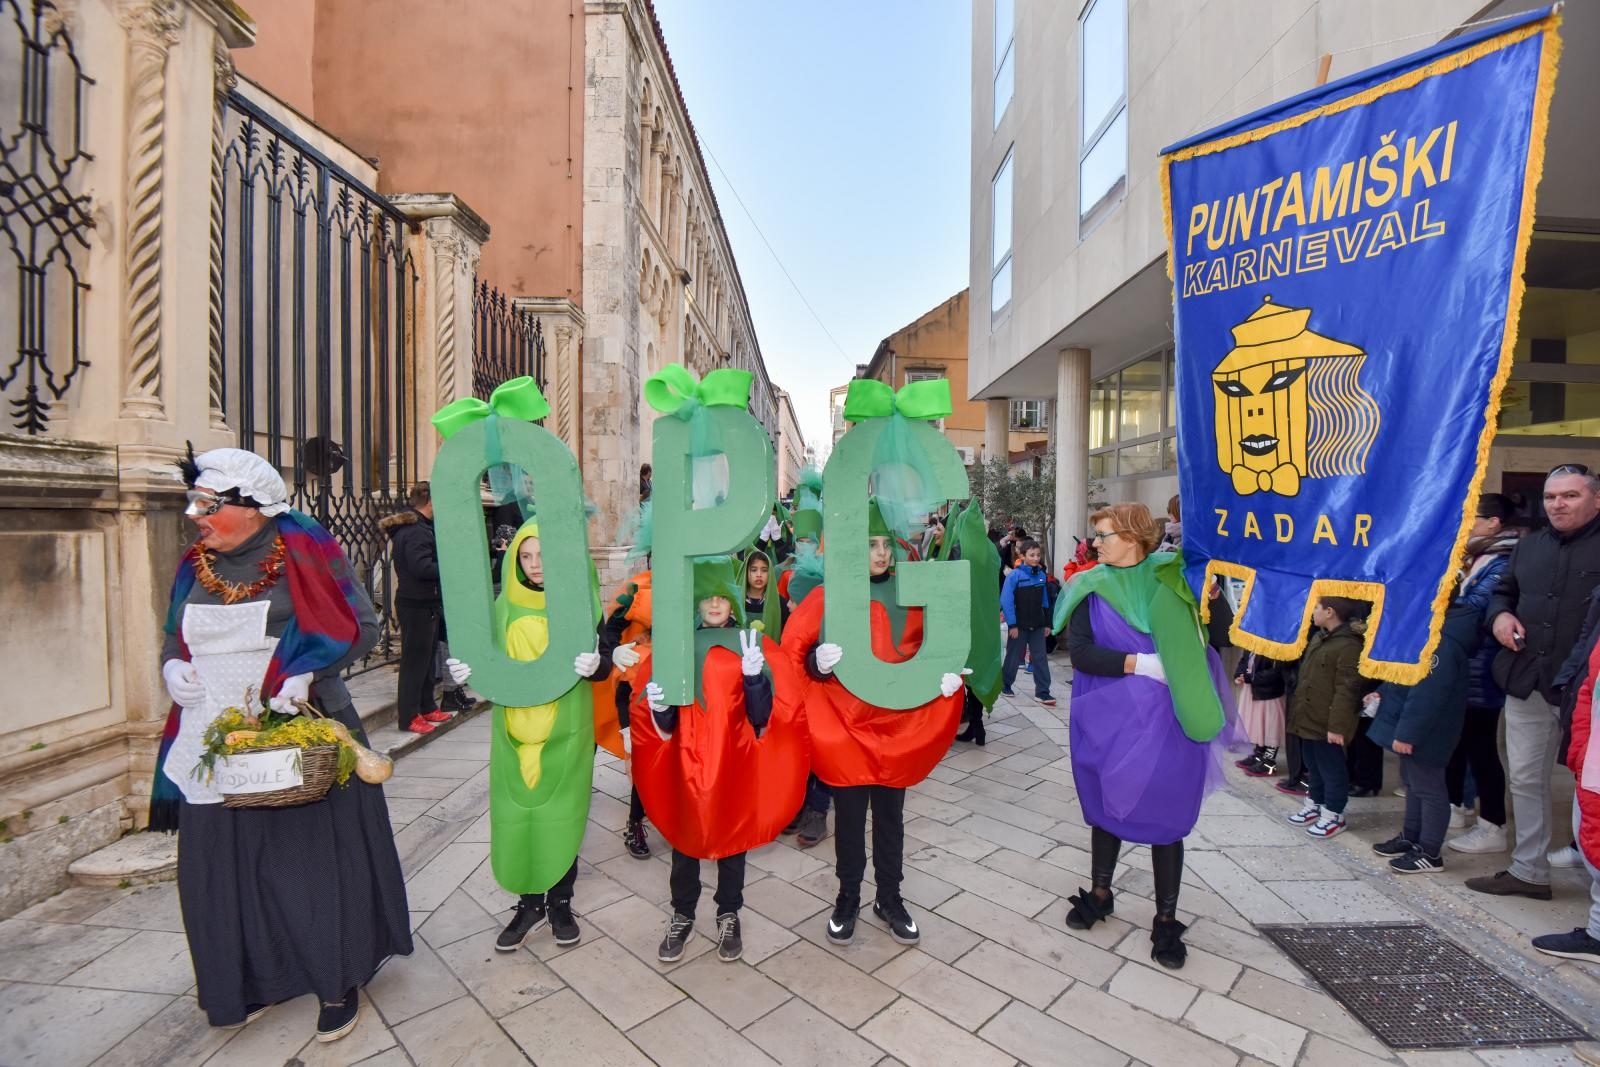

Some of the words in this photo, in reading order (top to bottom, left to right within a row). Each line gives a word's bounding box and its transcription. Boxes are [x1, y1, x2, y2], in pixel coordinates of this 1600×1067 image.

[1186, 120, 1458, 257] PUNTAMIŠKI
[1183, 198, 1446, 298] KARNEVAL
[1214, 508, 1372, 547] ZADAR
